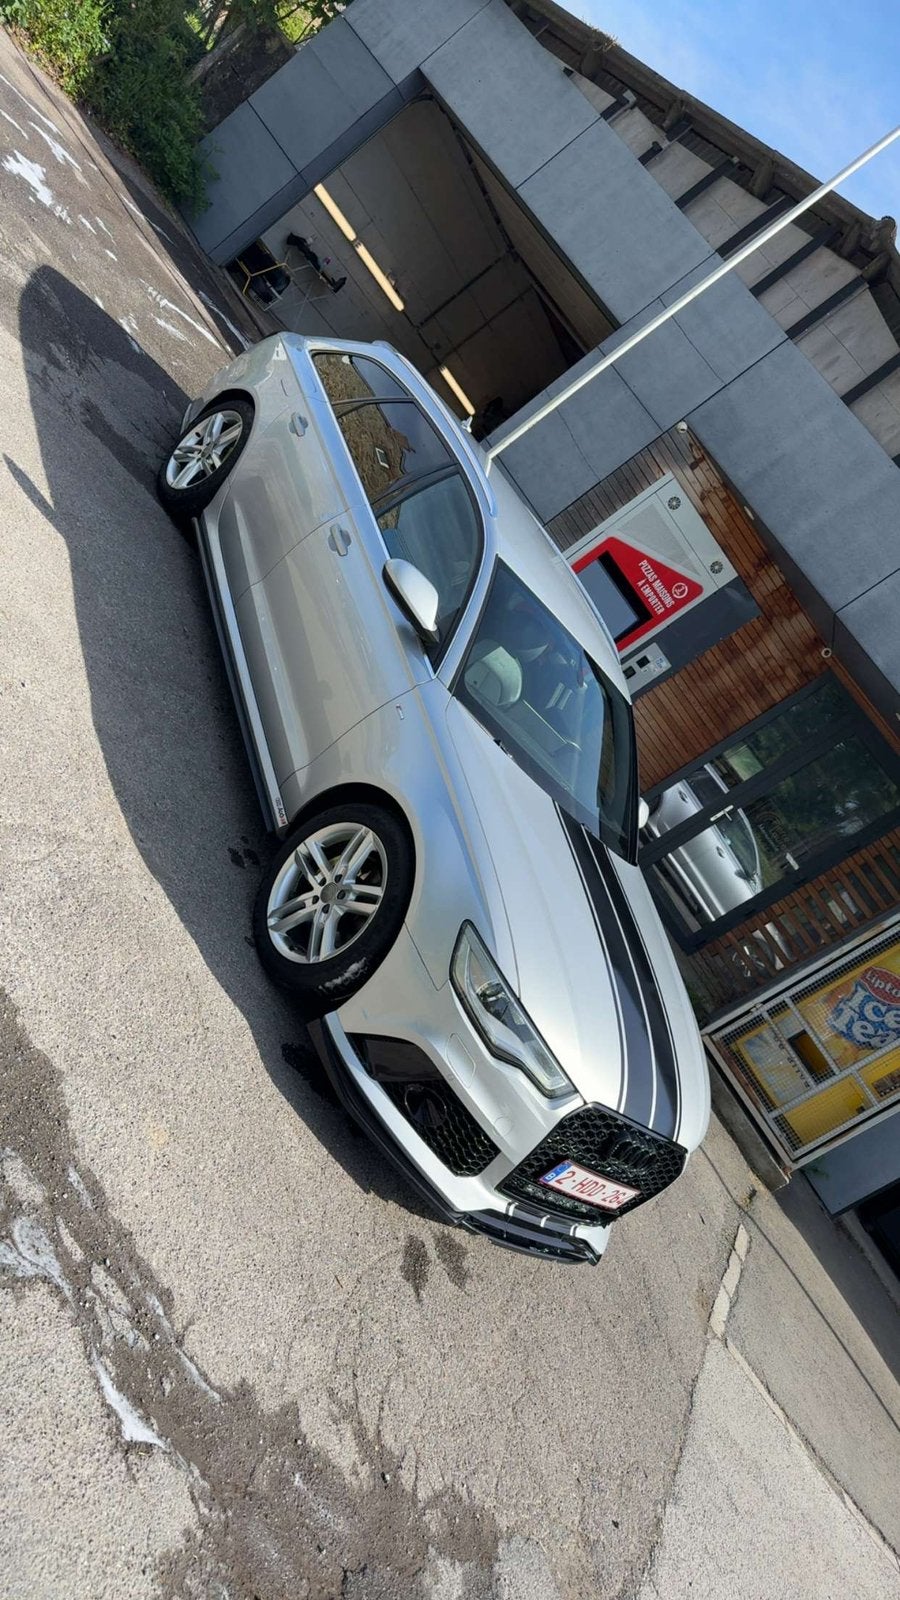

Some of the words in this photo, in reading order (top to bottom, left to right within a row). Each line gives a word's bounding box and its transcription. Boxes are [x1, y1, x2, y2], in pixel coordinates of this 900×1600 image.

[638, 559, 658, 582] PIZZAS
[652, 579, 676, 608] MAISONS
[640, 584, 665, 615] EMPORTER
